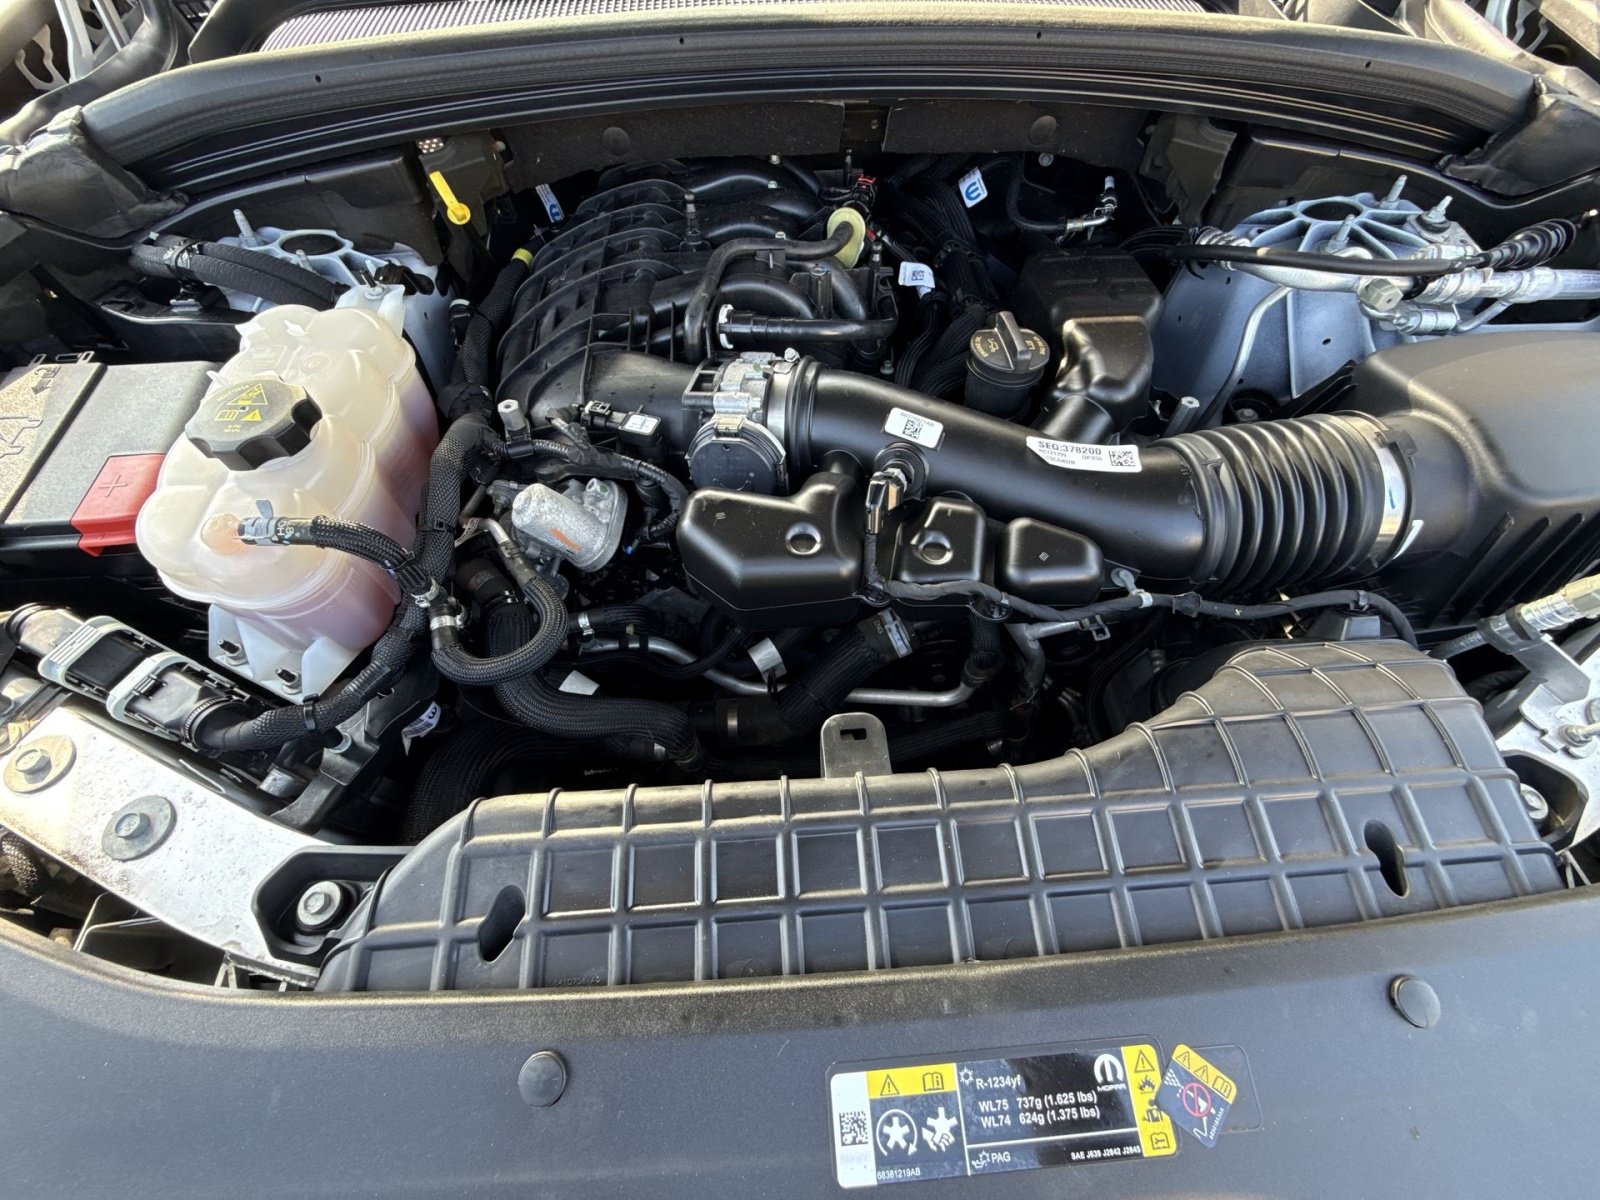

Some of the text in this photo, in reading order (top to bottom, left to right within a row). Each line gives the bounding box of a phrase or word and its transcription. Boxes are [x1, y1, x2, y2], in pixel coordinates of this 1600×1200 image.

[975, 1074, 1022, 1090] R-1234yf
[1096, 1083, 1127, 1092] MOPAR
[978, 1090, 1098, 1114] WL75 737g (1.625 lbs)
[980, 1106, 1100, 1129] WL74 624g (1.375 lbs)
[991, 1151, 1011, 1163] PAG
[1070, 1151, 1086, 1161] SAE
[1086, 1149, 1102, 1160] J639
